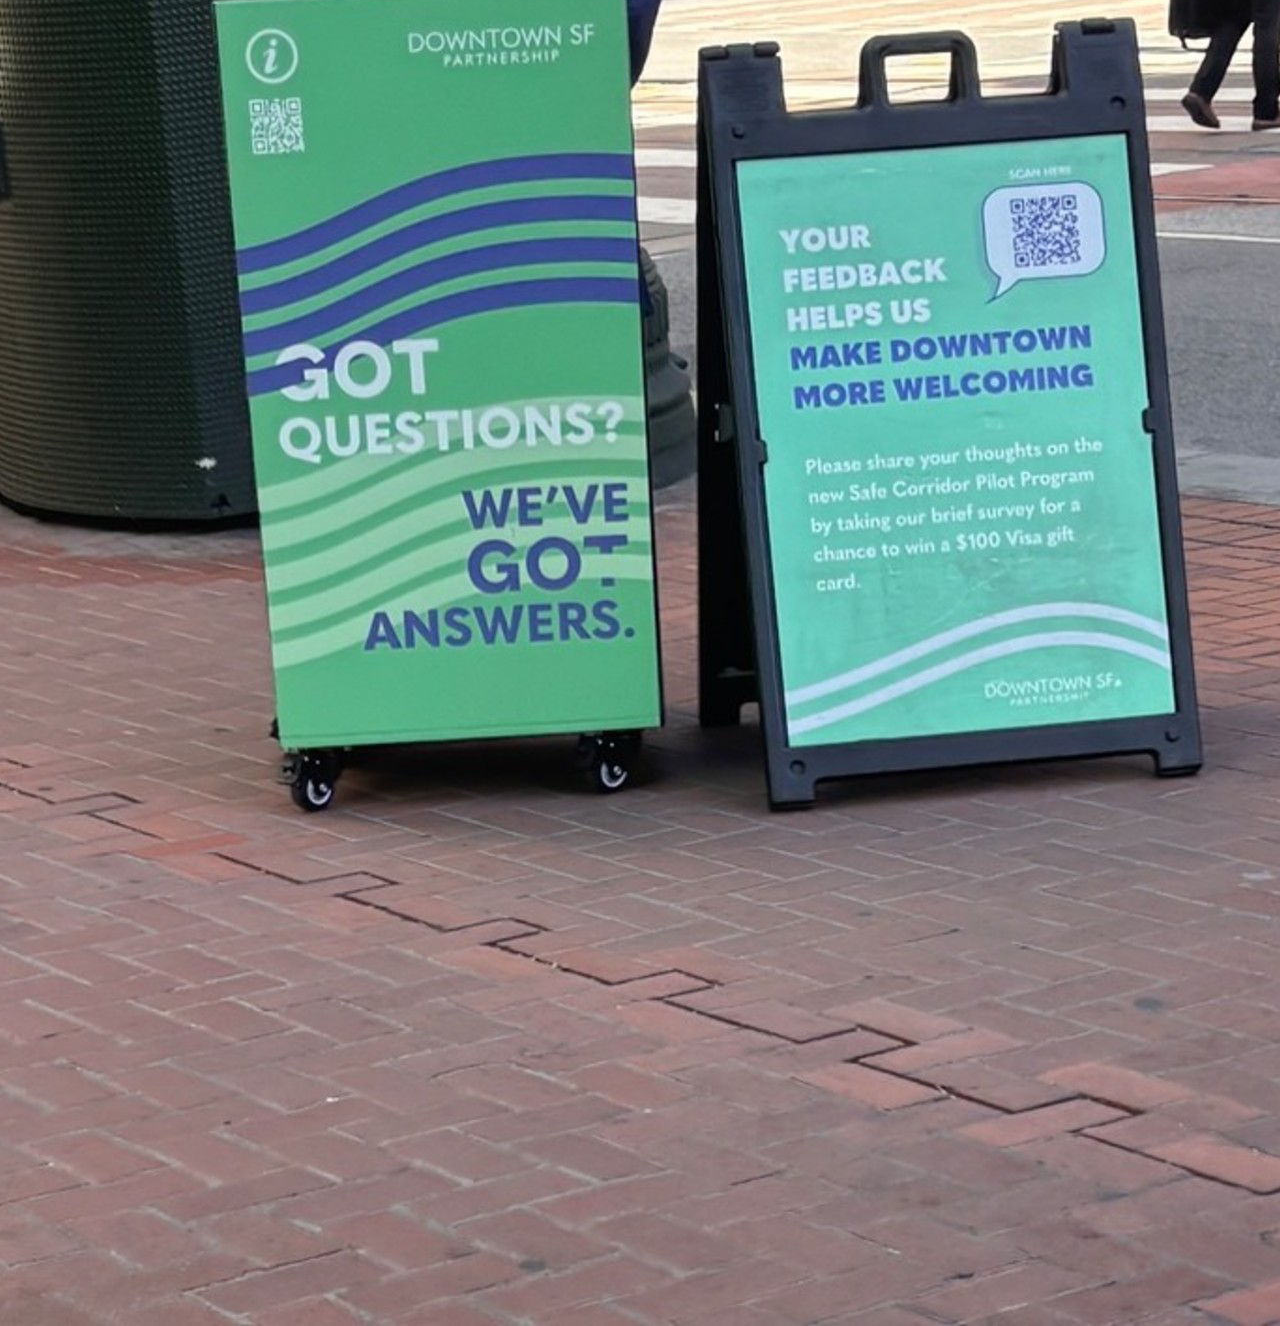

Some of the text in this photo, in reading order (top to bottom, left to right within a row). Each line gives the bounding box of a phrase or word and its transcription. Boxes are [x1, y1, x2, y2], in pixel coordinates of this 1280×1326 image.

[408, 23, 595, 54] DOWNTOWN SF
[443, 49, 561, 68] PARTNERSHIP
[779, 225, 871, 254] YOUR
[783, 257, 948, 293] FEEDBACK
[786, 298, 932, 332] HELPS US
[790, 325, 1092, 371] MAKE DOWNTOWN
[276, 338, 439, 402] GOT
[793, 364, 1095, 410] MORE WELCOMING
[279, 401, 624, 464] QUESTIONS?
[805, 436, 1104, 475] Please share your thoughts on the
[462, 482, 630, 530] WE'VE
[808, 470, 1095, 505] new Safe Corridor Pilot Program
[810, 496, 1081, 538] by taking our brief survey for a
[813, 525, 1076, 563] chance to win a $100 Visa gift
[467, 534, 630, 595] GOT
[816, 572, 861, 592] card.
[363, 599, 636, 651] ANSWERS.
[984, 672, 1114, 699] DOWNTOWN SF
[1009, 691, 1090, 707] PARTNERSHIP
